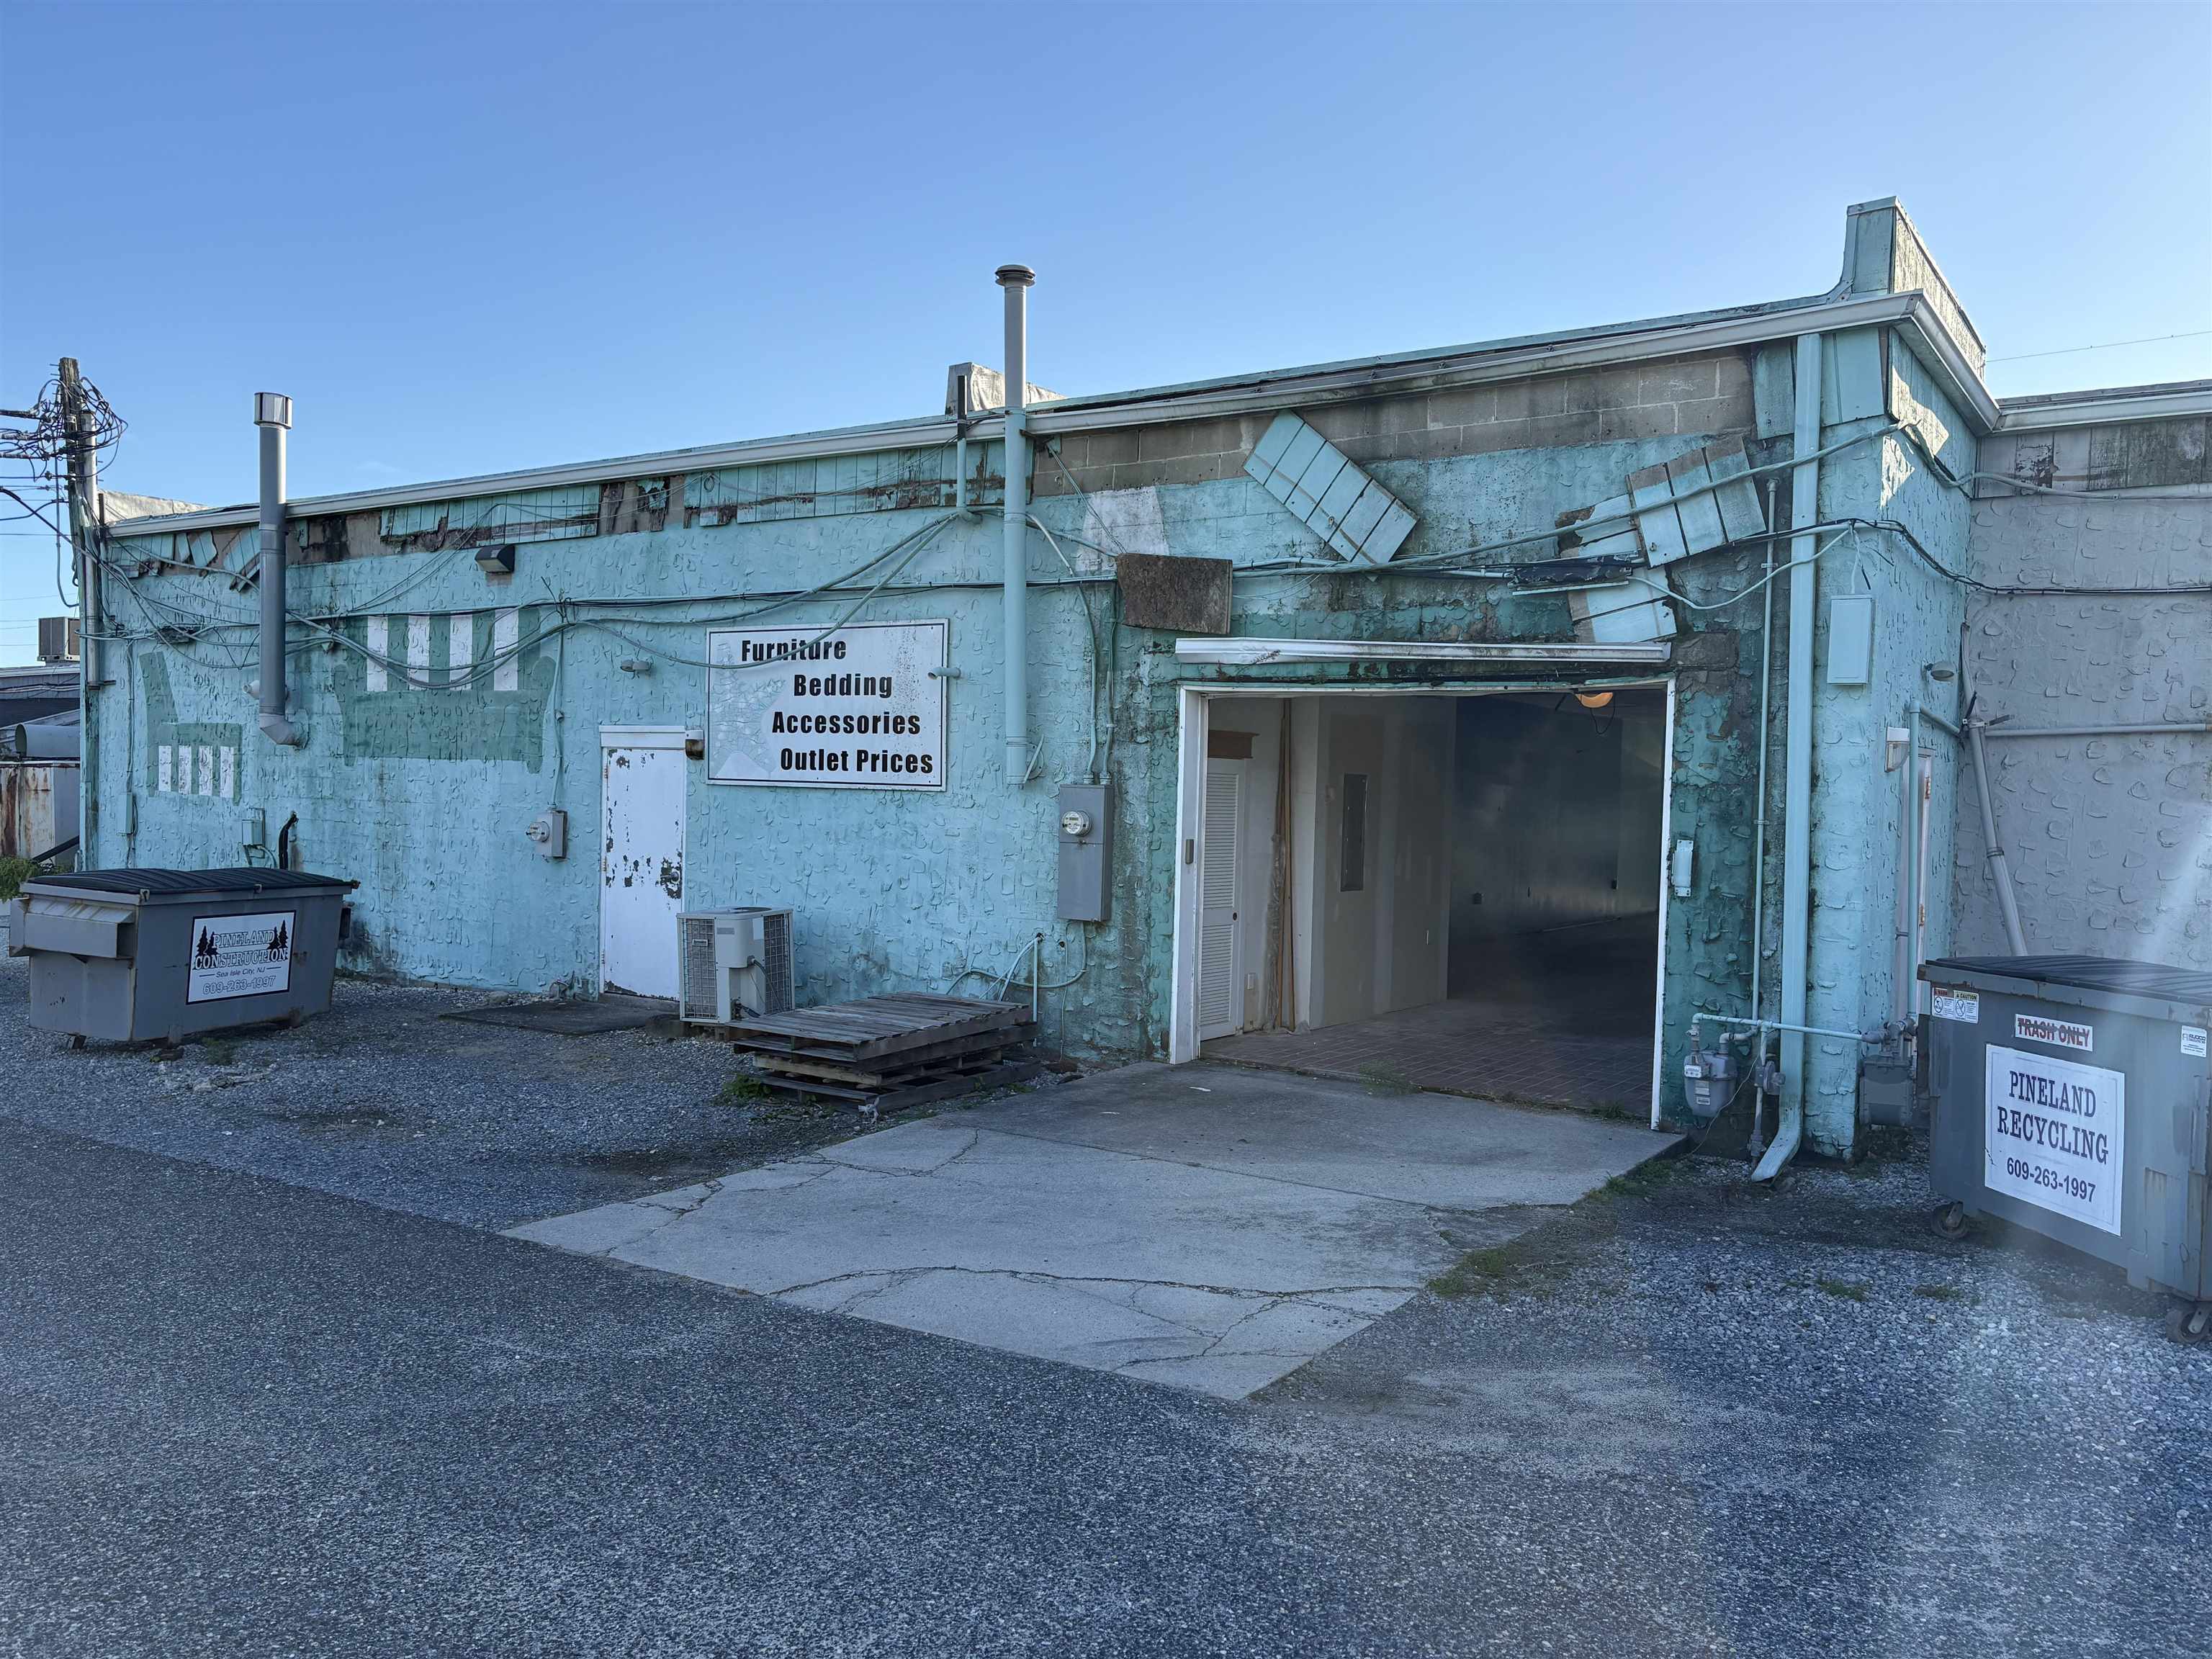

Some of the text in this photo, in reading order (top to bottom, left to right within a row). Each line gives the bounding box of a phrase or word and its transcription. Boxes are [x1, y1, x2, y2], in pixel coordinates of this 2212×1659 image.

[742, 639, 847, 662] Furniture
[794, 674, 892, 698] Bedding
[772, 711, 921, 734] Accessories
[781, 748, 933, 774] Outlet Prices
[212, 930, 276, 948] PINELAND
[194, 948, 288, 970] CONSTRUCTION
[202, 975, 276, 994] 609-263-1997
[2018, 1017, 2090, 1047] TRASH ONLY
[2009, 1071, 2096, 1118] PINELAND
[1997, 1106, 2108, 1165] RECYCLING
[2007, 1157, 2096, 1202] 609-263-1997
